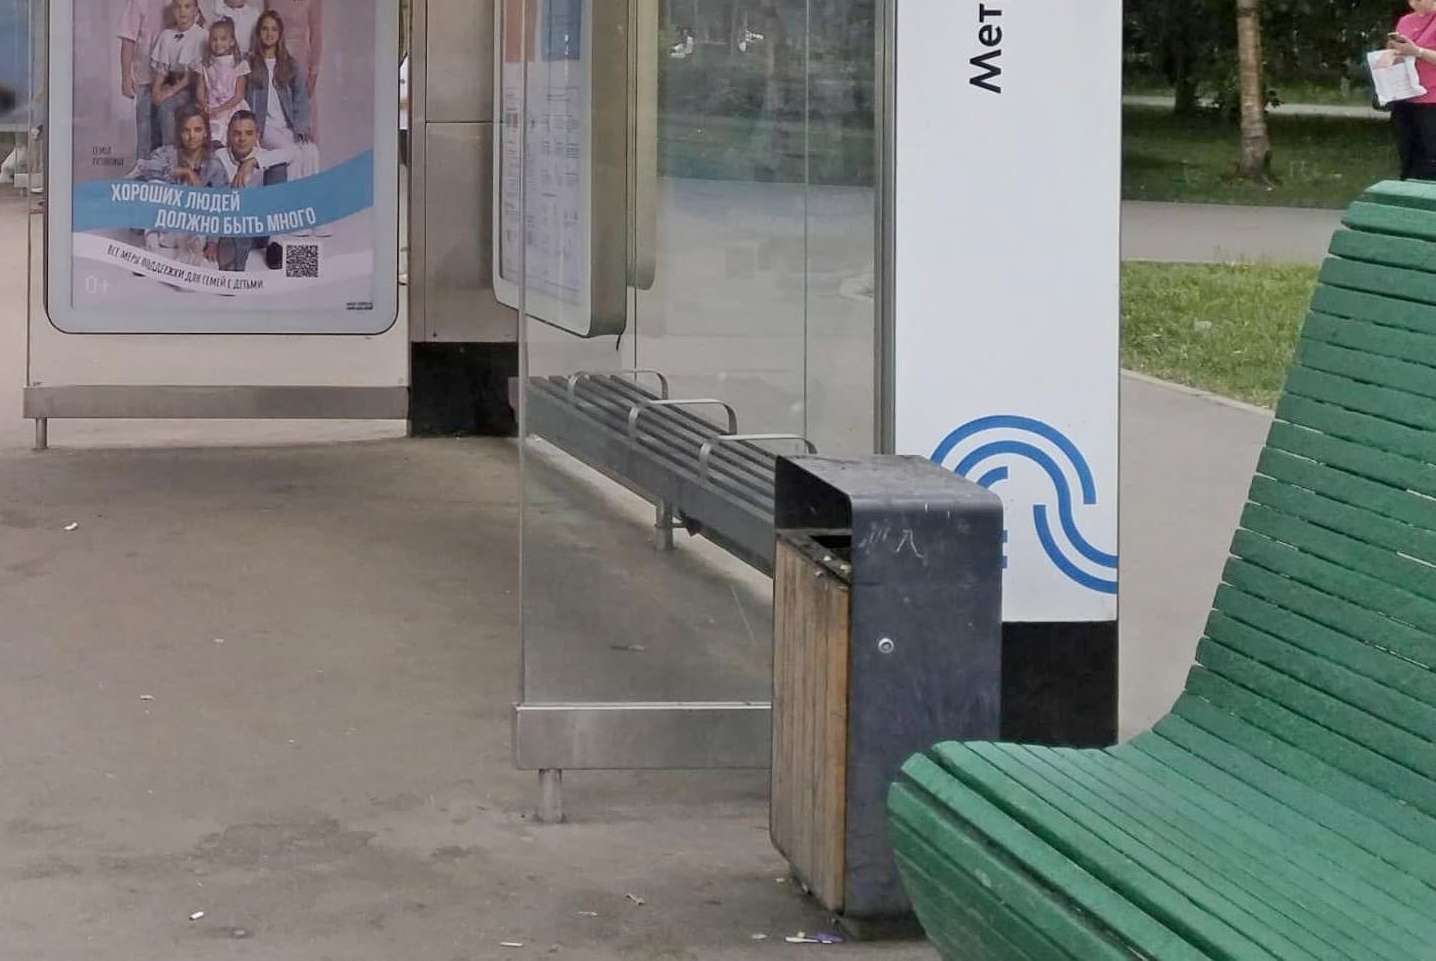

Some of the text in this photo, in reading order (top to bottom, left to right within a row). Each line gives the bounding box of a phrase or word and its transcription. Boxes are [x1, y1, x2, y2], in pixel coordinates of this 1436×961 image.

[111, 183, 240, 213] ХОРОШИХ ЛЮДЕЙ
[155, 207, 316, 235] ДОЛЖНО БЫТЬ МНОГО
